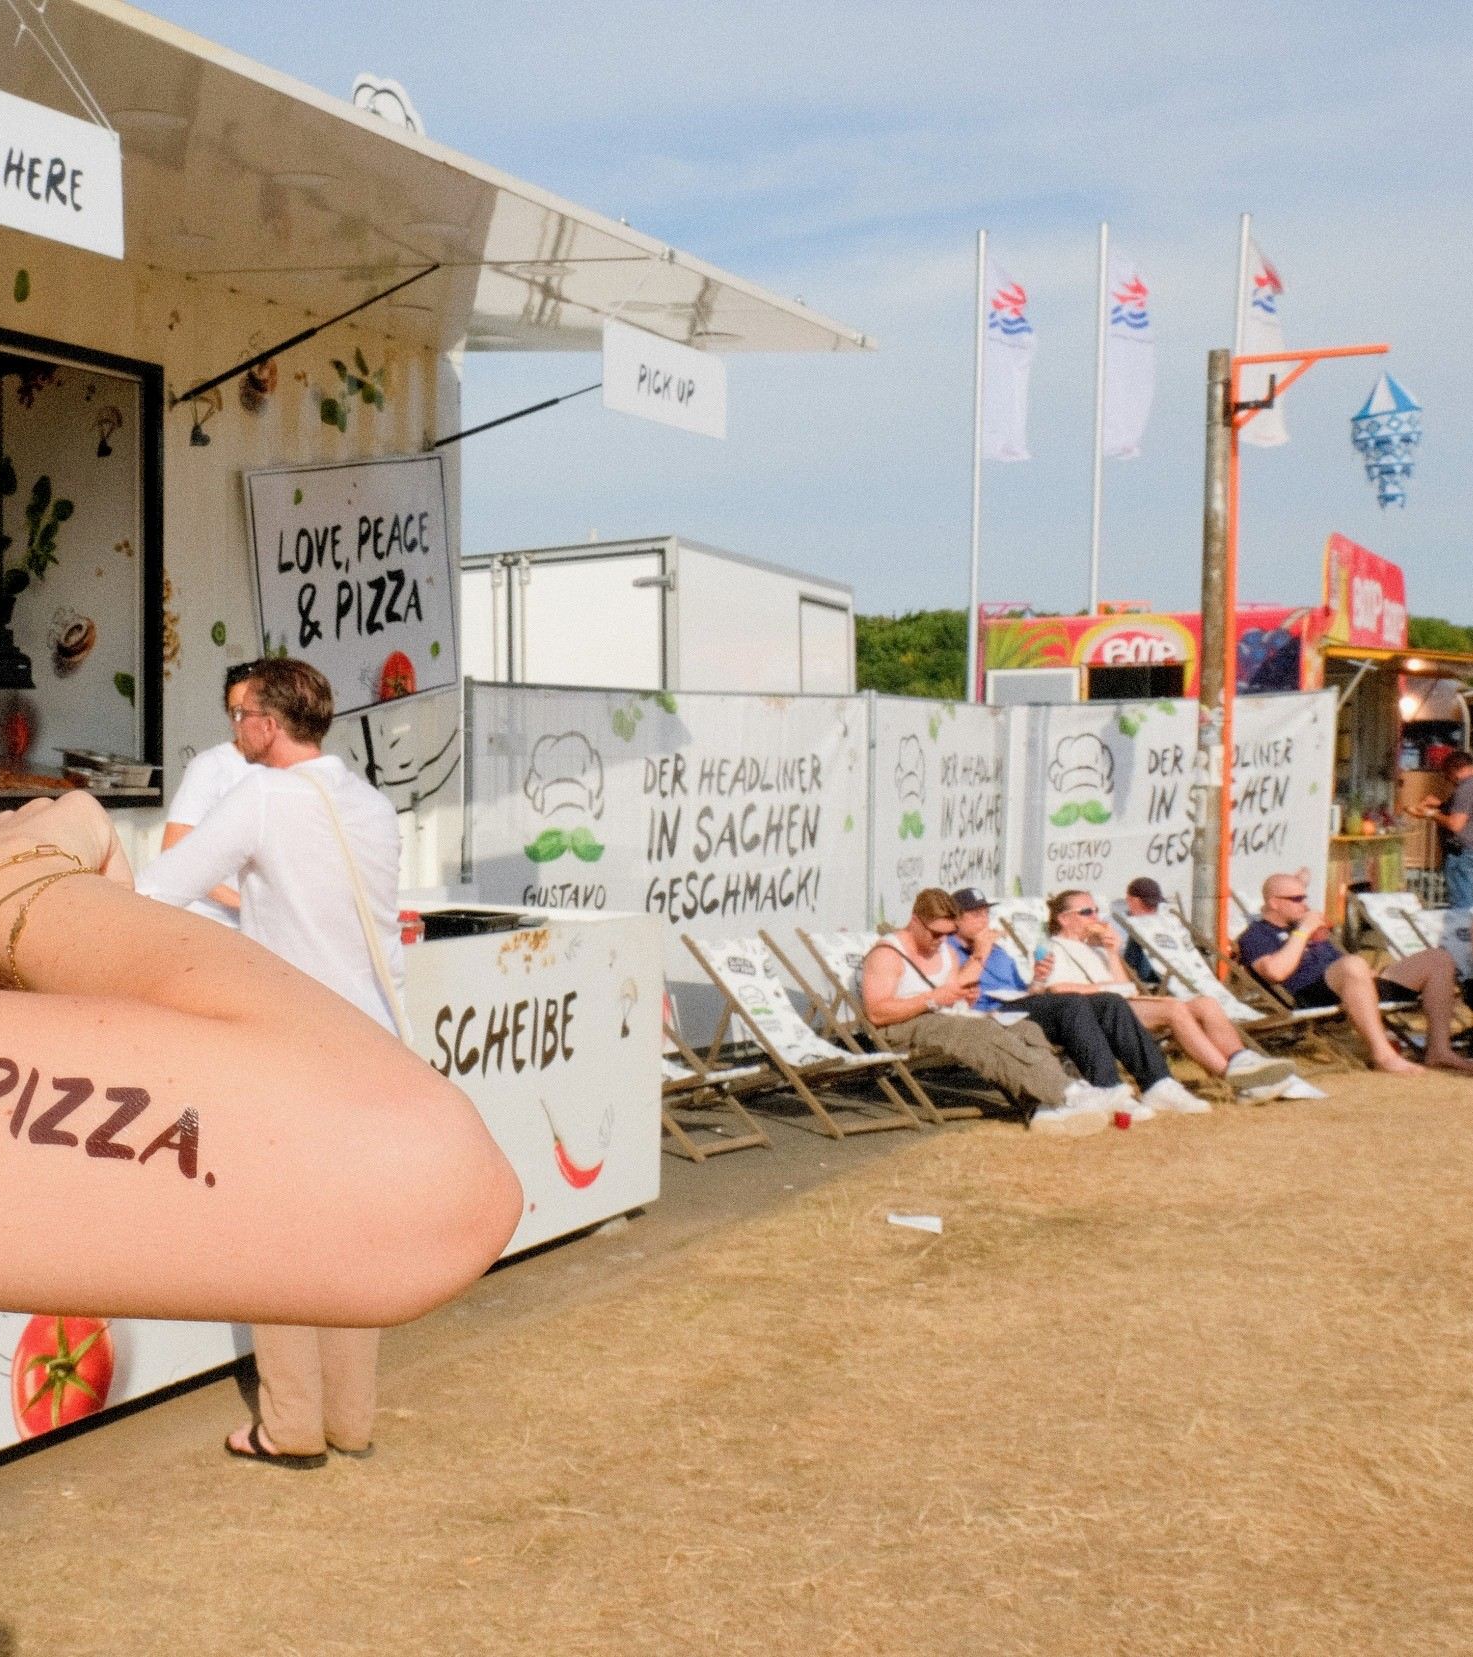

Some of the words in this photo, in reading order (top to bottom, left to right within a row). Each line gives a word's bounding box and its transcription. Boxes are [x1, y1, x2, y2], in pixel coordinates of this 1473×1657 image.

[2, 146, 84, 212] HERE
[637, 363, 672, 400] PICK
[677, 377, 696, 407] UP
[277, 524, 351, 575] LOVE,
[356, 511, 430, 562] PEACE
[297, 582, 323, 649] &
[335, 568, 423, 641] PIZZA
[642, 751, 688, 798] DER
[698, 751, 823, 798] HEADLINER
[1147, 743, 1184, 777] DER
[1148, 783, 1178, 825] IN
[647, 804, 682, 864] IN
[692, 801, 821, 864] SACHEN
[1046, 838, 1112, 863] GUSTAVO
[645, 865, 821, 924] GESCHMACK!
[1055, 860, 1103, 883] GUSTO
[521, 882, 607, 910] GUSTAVO
[429, 990, 578, 1080] SCHEIBE
